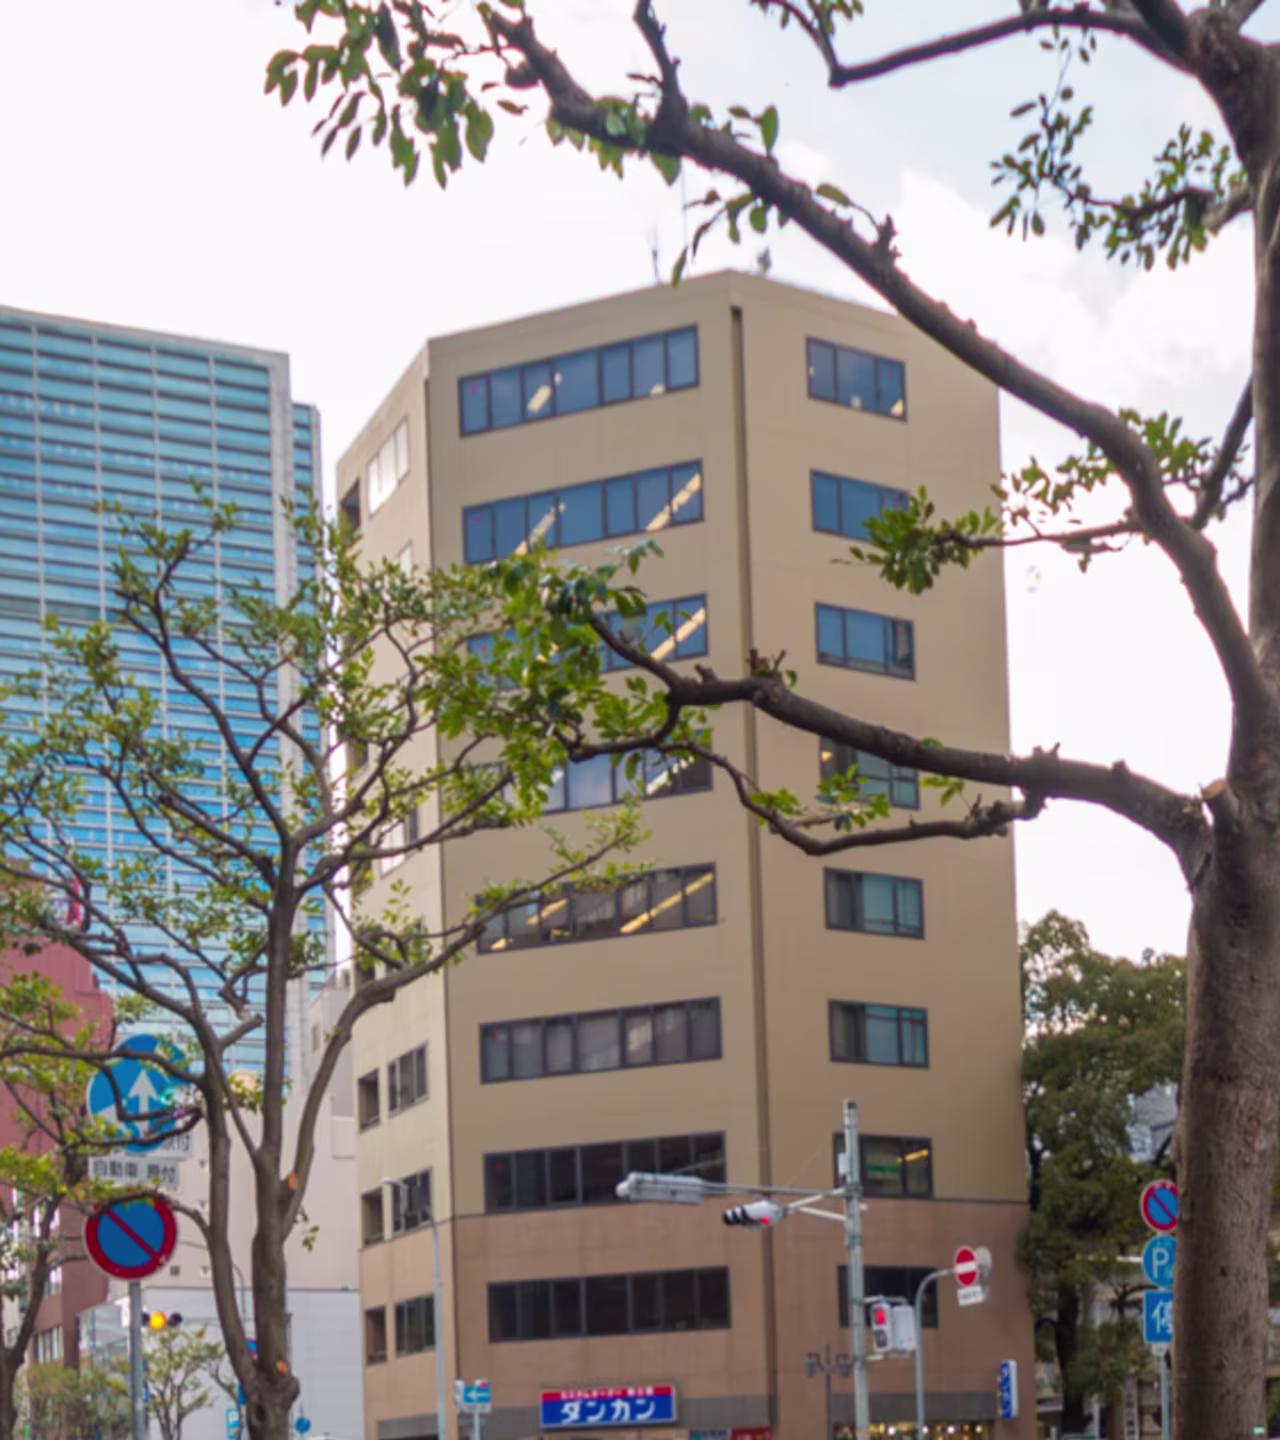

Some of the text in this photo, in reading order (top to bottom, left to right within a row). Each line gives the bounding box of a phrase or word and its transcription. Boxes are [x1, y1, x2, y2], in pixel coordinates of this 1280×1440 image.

[1152, 1247, 1170, 1279] P
[560, 1398, 655, 1424] ダンカン
